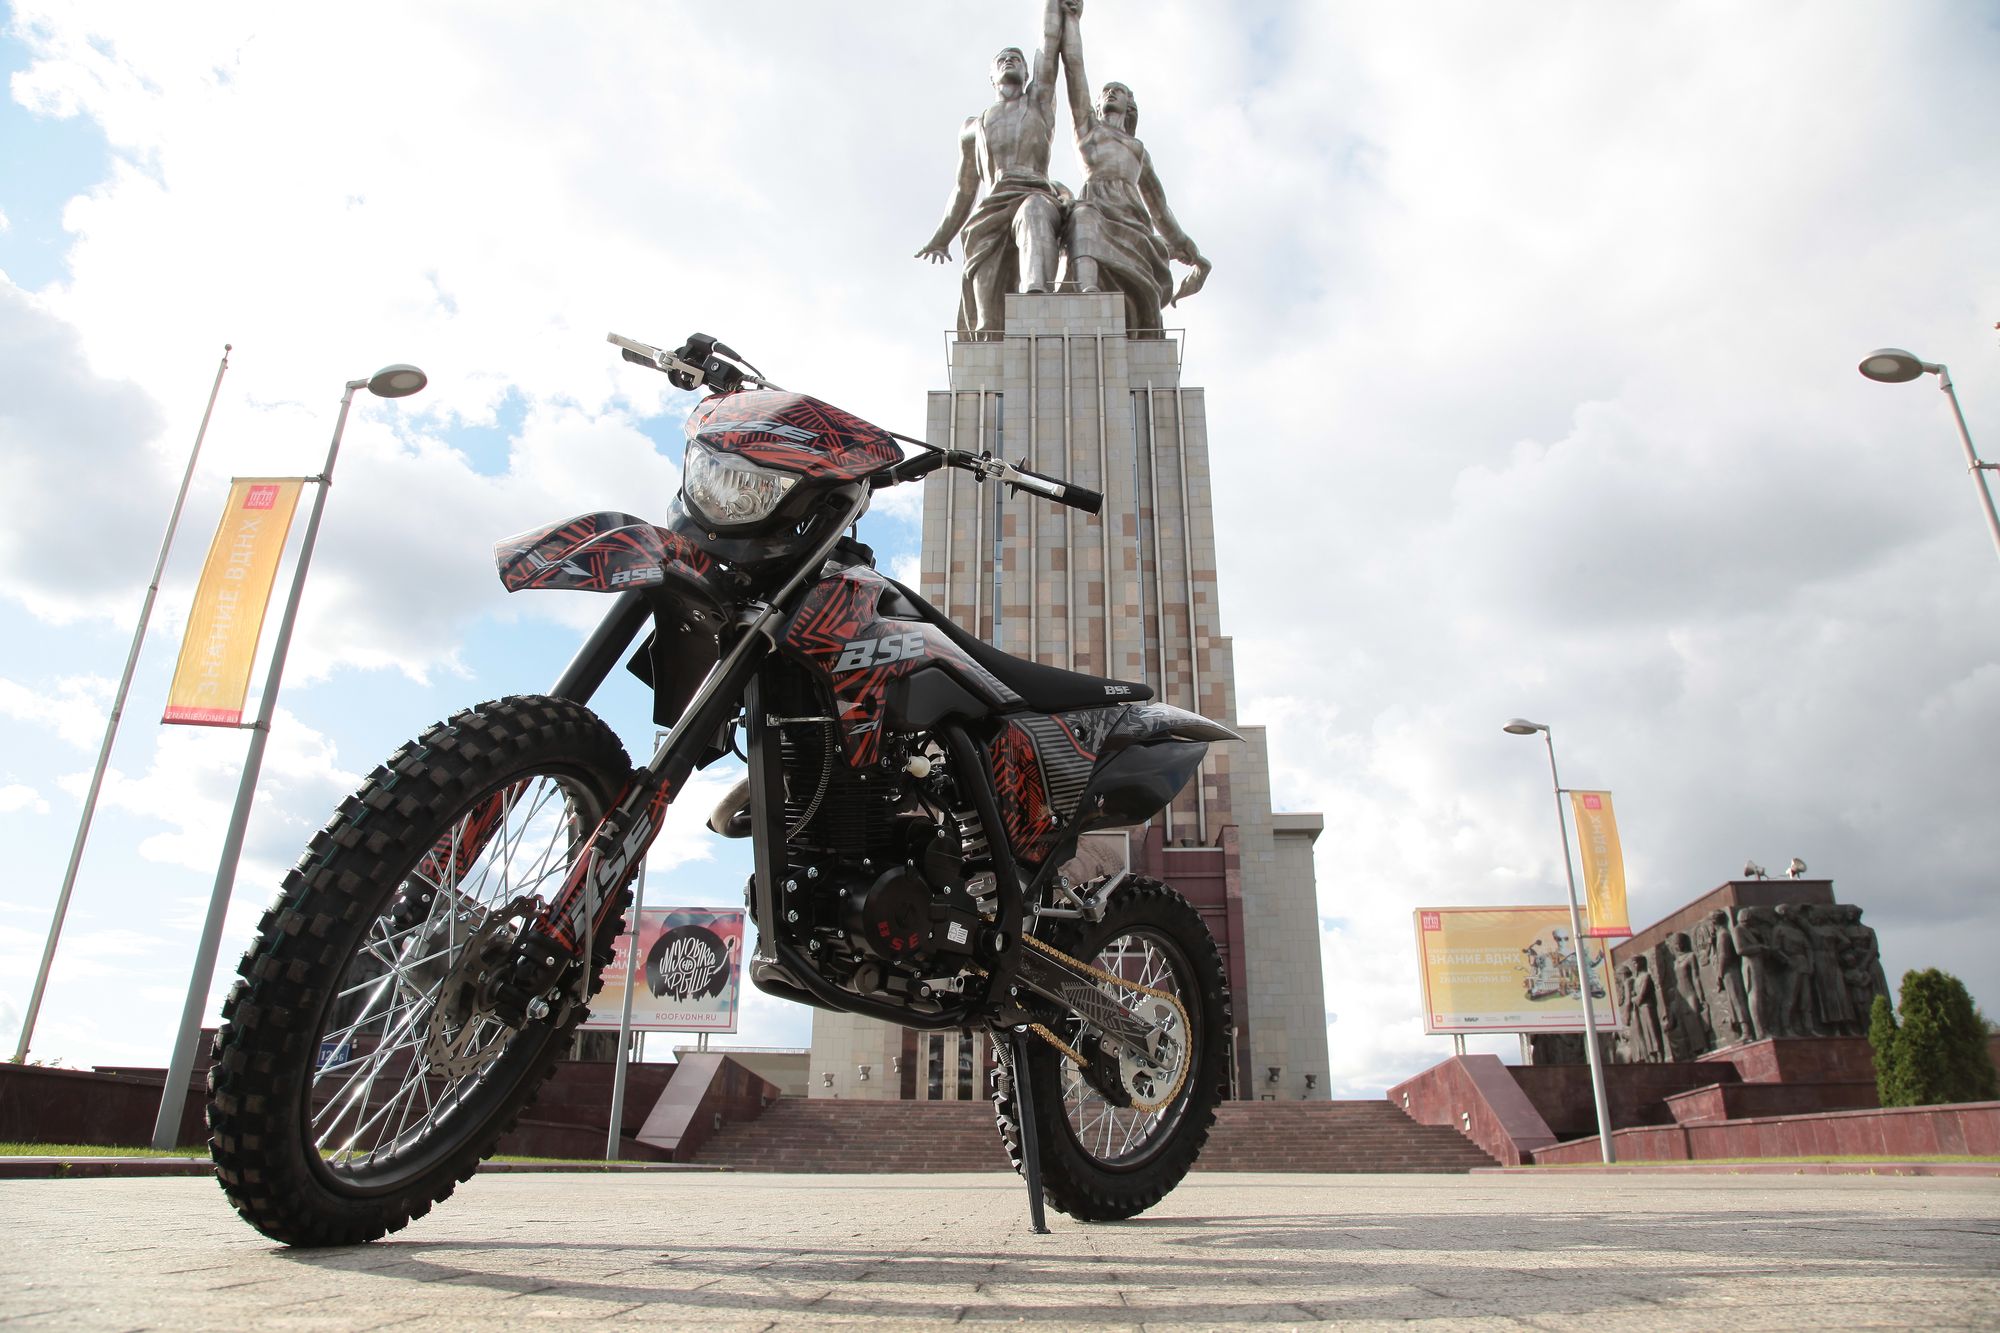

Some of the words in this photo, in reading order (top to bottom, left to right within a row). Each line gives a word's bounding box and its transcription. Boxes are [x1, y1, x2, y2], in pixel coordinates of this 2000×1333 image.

[700, 420, 821, 442] BSE
[611, 567, 663, 586] BSE
[832, 631, 925, 673] BSE
[1104, 685, 1132, 695] BSE
[877, 920, 920, 951] BSE
